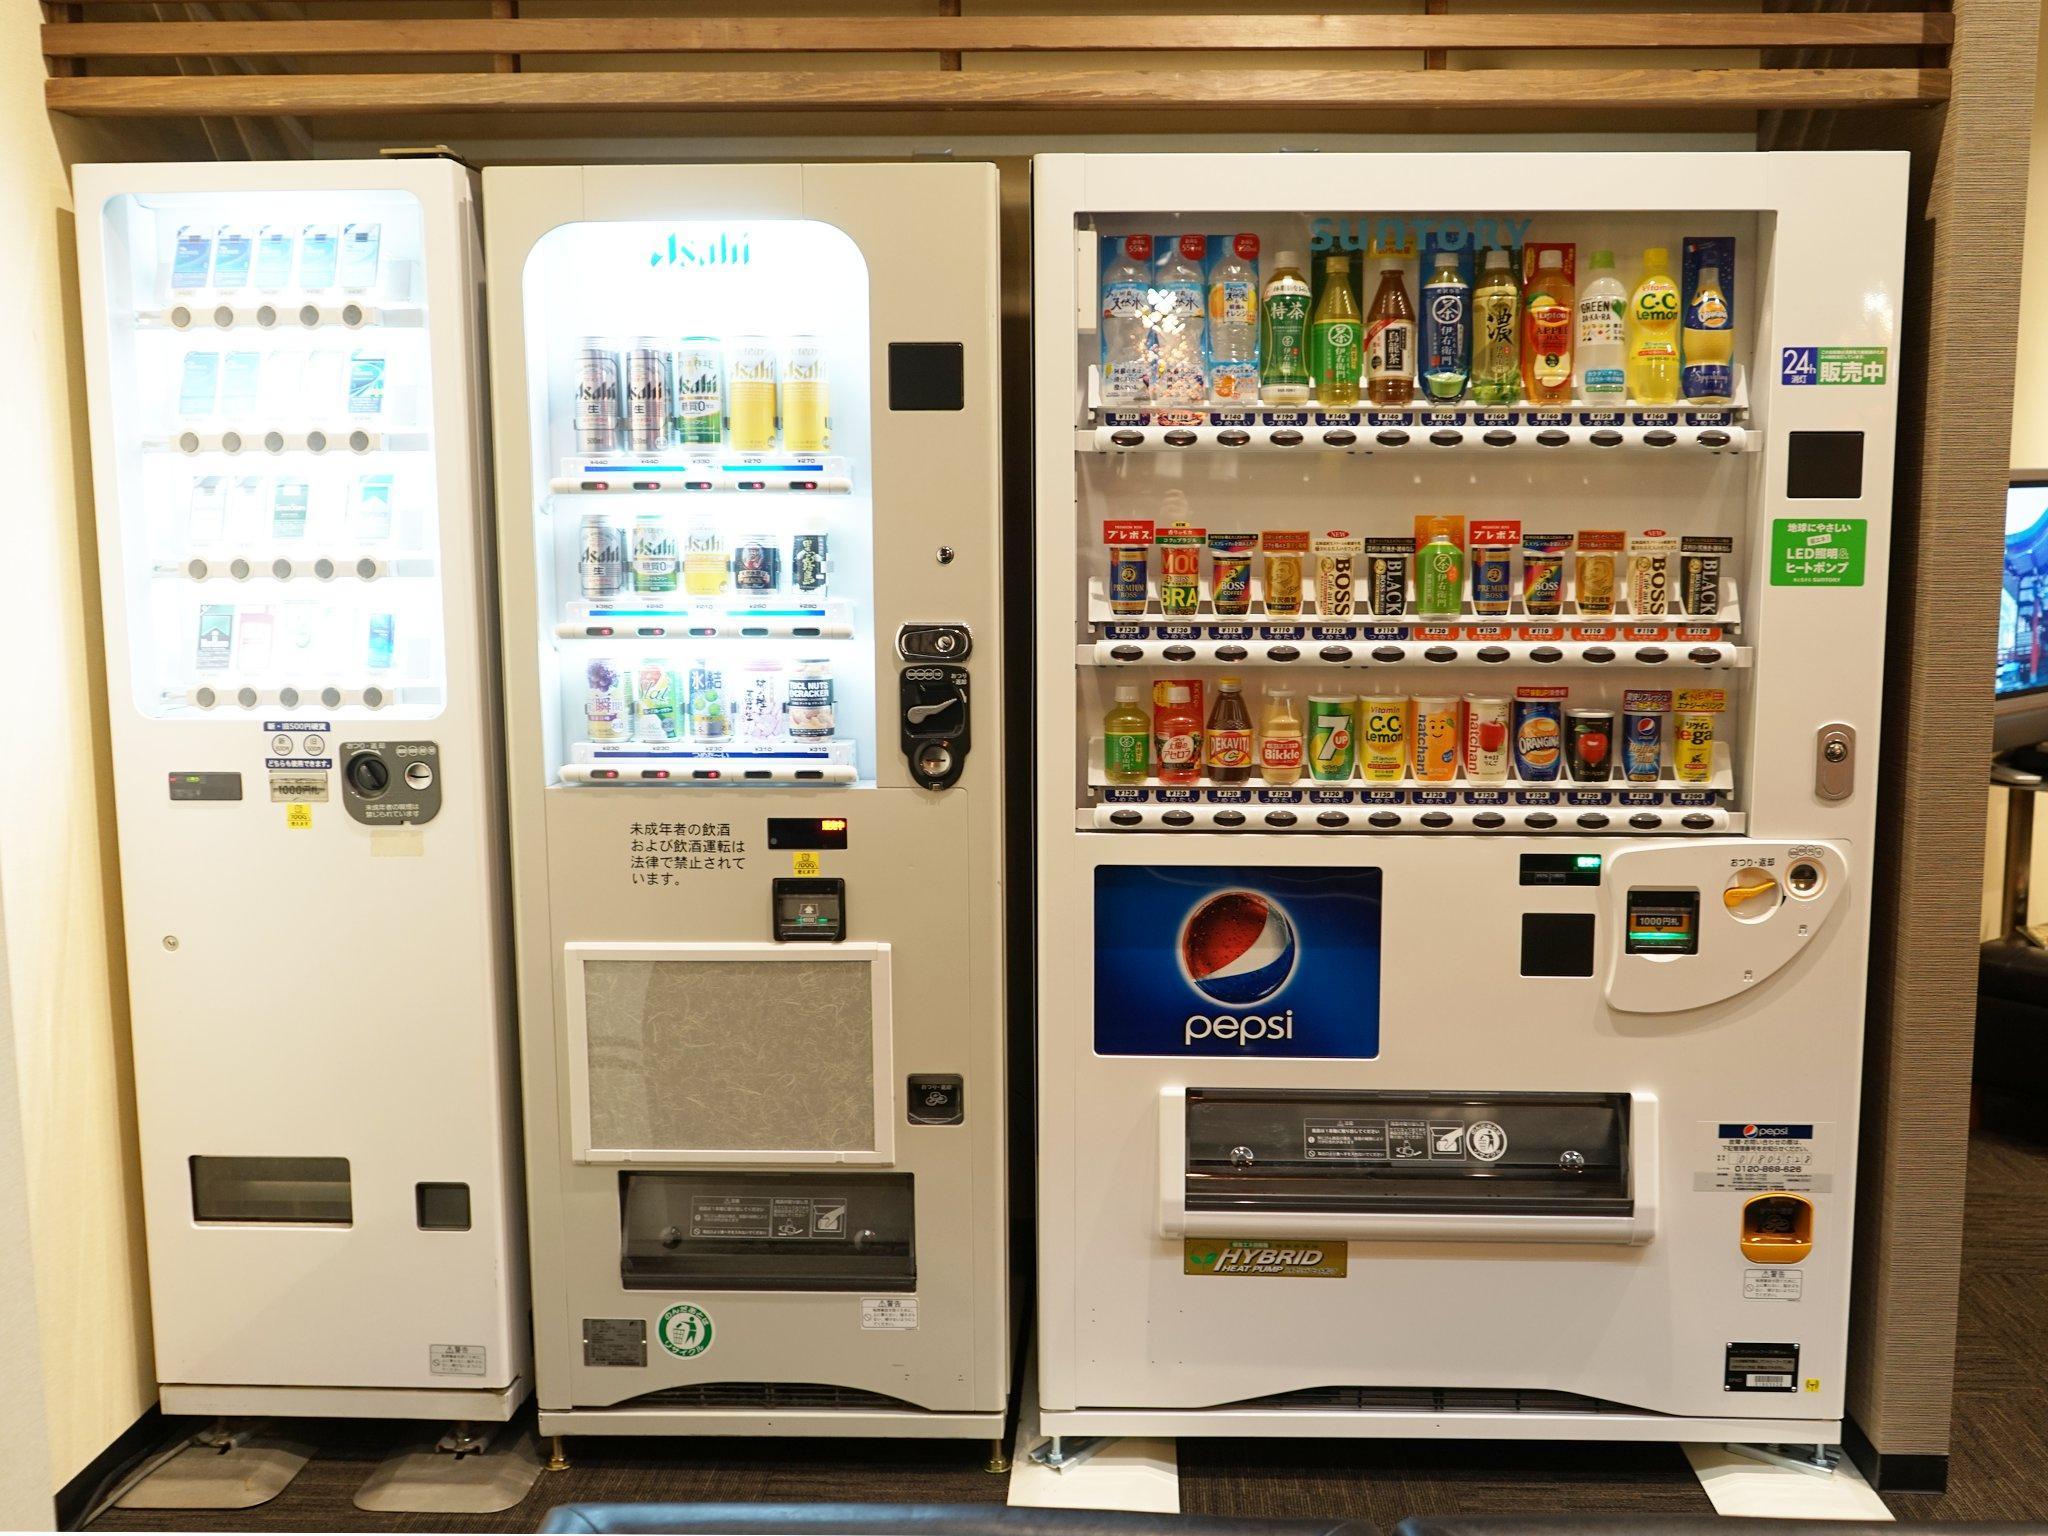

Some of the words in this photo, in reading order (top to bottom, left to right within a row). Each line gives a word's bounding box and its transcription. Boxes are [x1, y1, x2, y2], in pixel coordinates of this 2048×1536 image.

[650, 231, 750, 268] Asahi
[1271, 302, 1304, 320] 特茶
[1581, 301, 1610, 313] GREEN
[1487, 308, 1512, 344] 濃
[1330, 326, 1351, 344] 茶
[1441, 326, 1452, 365] 伊右衛門
[1336, 348, 1346, 380] 伊右衛門
[1783, 349, 1816, 375] 24h
[1820, 361, 1884, 383] 販売中
[588, 404, 600, 414] 生
[635, 404, 645, 414] 生
[1787, 523, 1852, 533] 地球にやさしい
[582, 546, 619, 563] Asahi
[634, 538, 675, 556] Asahi
[594, 566, 604, 576] 生
[1786, 561, 1850, 574] ヒートポンプ
[1221, 582, 1245, 590] BOSS
[1335, 558, 1350, 615] BOSS
[1386, 561, 1402, 615] BLACK
[1437, 574, 1447, 607] 伊右衛門
[1536, 581, 1559, 591] BOSS
[1651, 557, 1666, 615] BOSS
[1701, 559, 1718, 615] BLACK
[1371, 706, 1400, 714] Vitamin
[1317, 715, 1350, 760] 7
[1335, 736, 1347, 744] UP
[1366, 731, 1403, 742] Lemon
[1469, 713, 1480, 775] natchan!
[1417, 715, 1428, 776] natchan!
[1264, 749, 1300, 760] Bikkle
[630, 822, 731, 836] 未成年者の飲酒
[630, 839, 745, 853] および飲酒運転は
[630, 856, 746, 870] 法律で禁止されて
[1730, 857, 1775, 867] おつり・返却
[632, 872, 680, 886] います。
[1640, 917, 1680, 926] 1000円札
[1185, 1010, 1293, 1046] pepsi
[1760, 1126, 1788, 1137] pepsi
[1214, 1248, 1323, 1272] HYBRID
[664, 1341, 704, 1356] リサイクル
